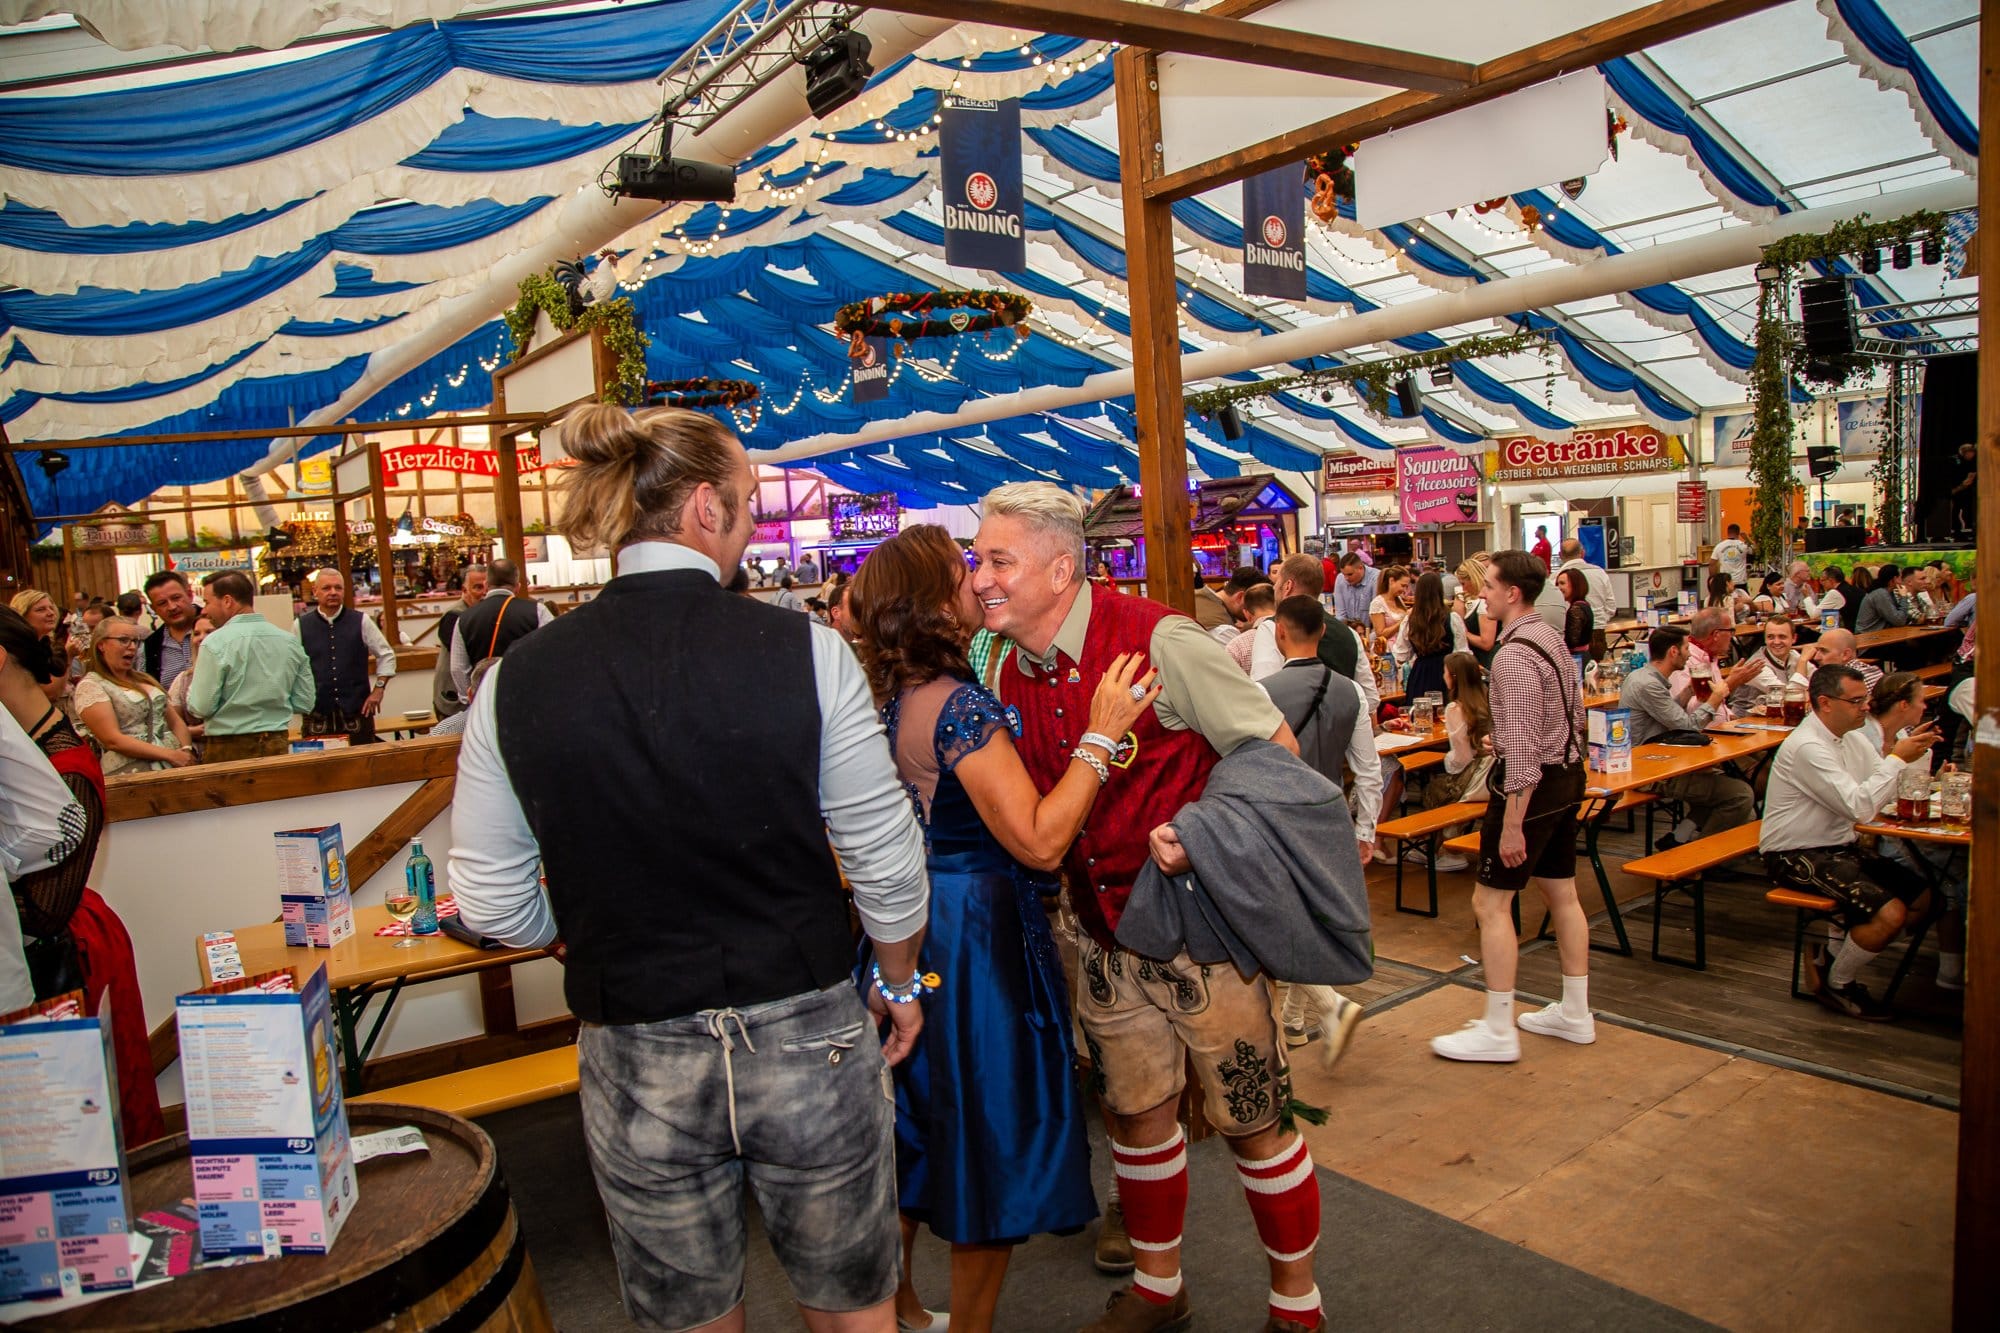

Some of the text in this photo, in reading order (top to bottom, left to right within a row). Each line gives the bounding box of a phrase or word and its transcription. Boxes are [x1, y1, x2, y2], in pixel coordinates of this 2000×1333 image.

[958, 97, 995, 108] HERZEN
[945, 204, 1021, 238] BINDING
[1246, 243, 1304, 271] BINDING
[854, 363, 887, 384] BINDING
[1506, 431, 1658, 466] Getränke
[384, 448, 476, 472] Herzlich
[1495, 468, 1532, 479] FESTBIER
[1537, 466, 1559, 477] COLA
[1563, 462, 1618, 475] WEIZENBIER
[1403, 477, 1413, 492] &
[1416, 474, 1478, 493] Accessoire
[1414, 497, 1449, 511] Filzherzen
[423, 518, 464, 535] Secco
[182, 557, 240, 569] Toiletten
[287, 1139, 307, 1149] FES
[87, 1169, 111, 1182] FES
